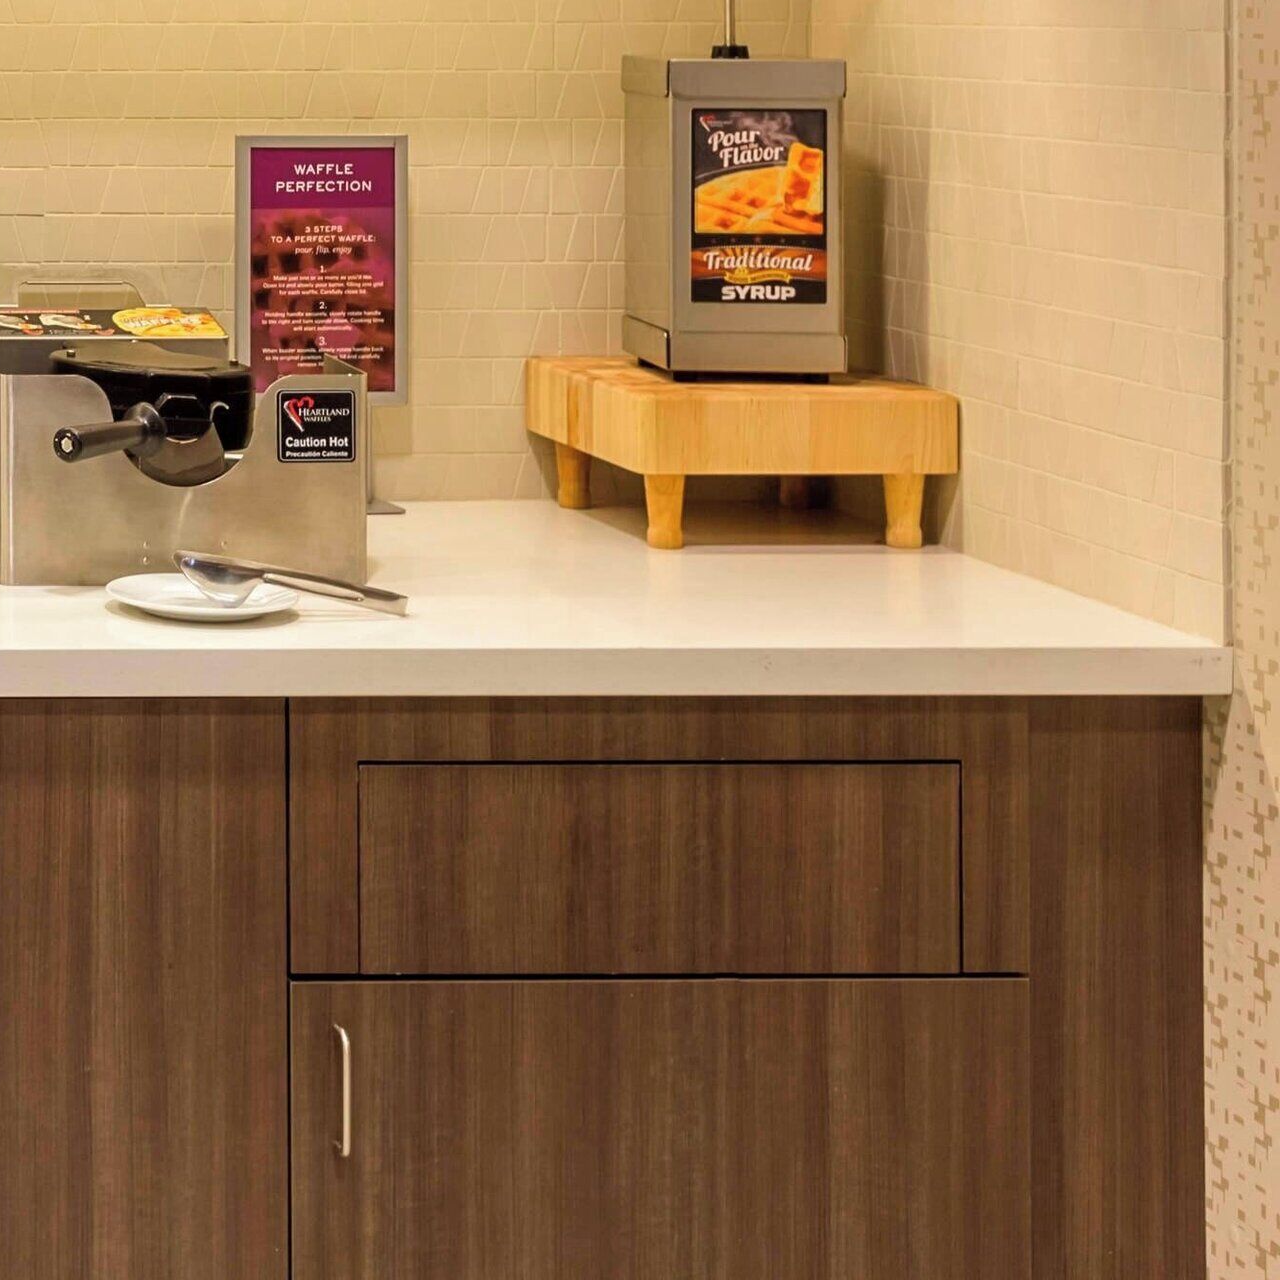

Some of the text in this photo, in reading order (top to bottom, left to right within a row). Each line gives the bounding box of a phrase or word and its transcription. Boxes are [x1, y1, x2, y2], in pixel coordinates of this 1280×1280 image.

[708, 130, 760, 152] Pour
[719, 145, 784, 168] Flavor
[294, 163, 354, 176] WAFFLE
[276, 180, 372, 193] PERFECTION
[295, 235, 336, 243] PERFECT
[332, 246, 352, 255] enjoy
[703, 250, 813, 271] Traditional
[319, 265, 327, 273] 1.
[721, 285, 796, 301] SYRUP
[319, 337, 327, 346] 3.
[298, 407, 350, 417] HEARTLAND
[285, 436, 349, 448] Caution Hot
